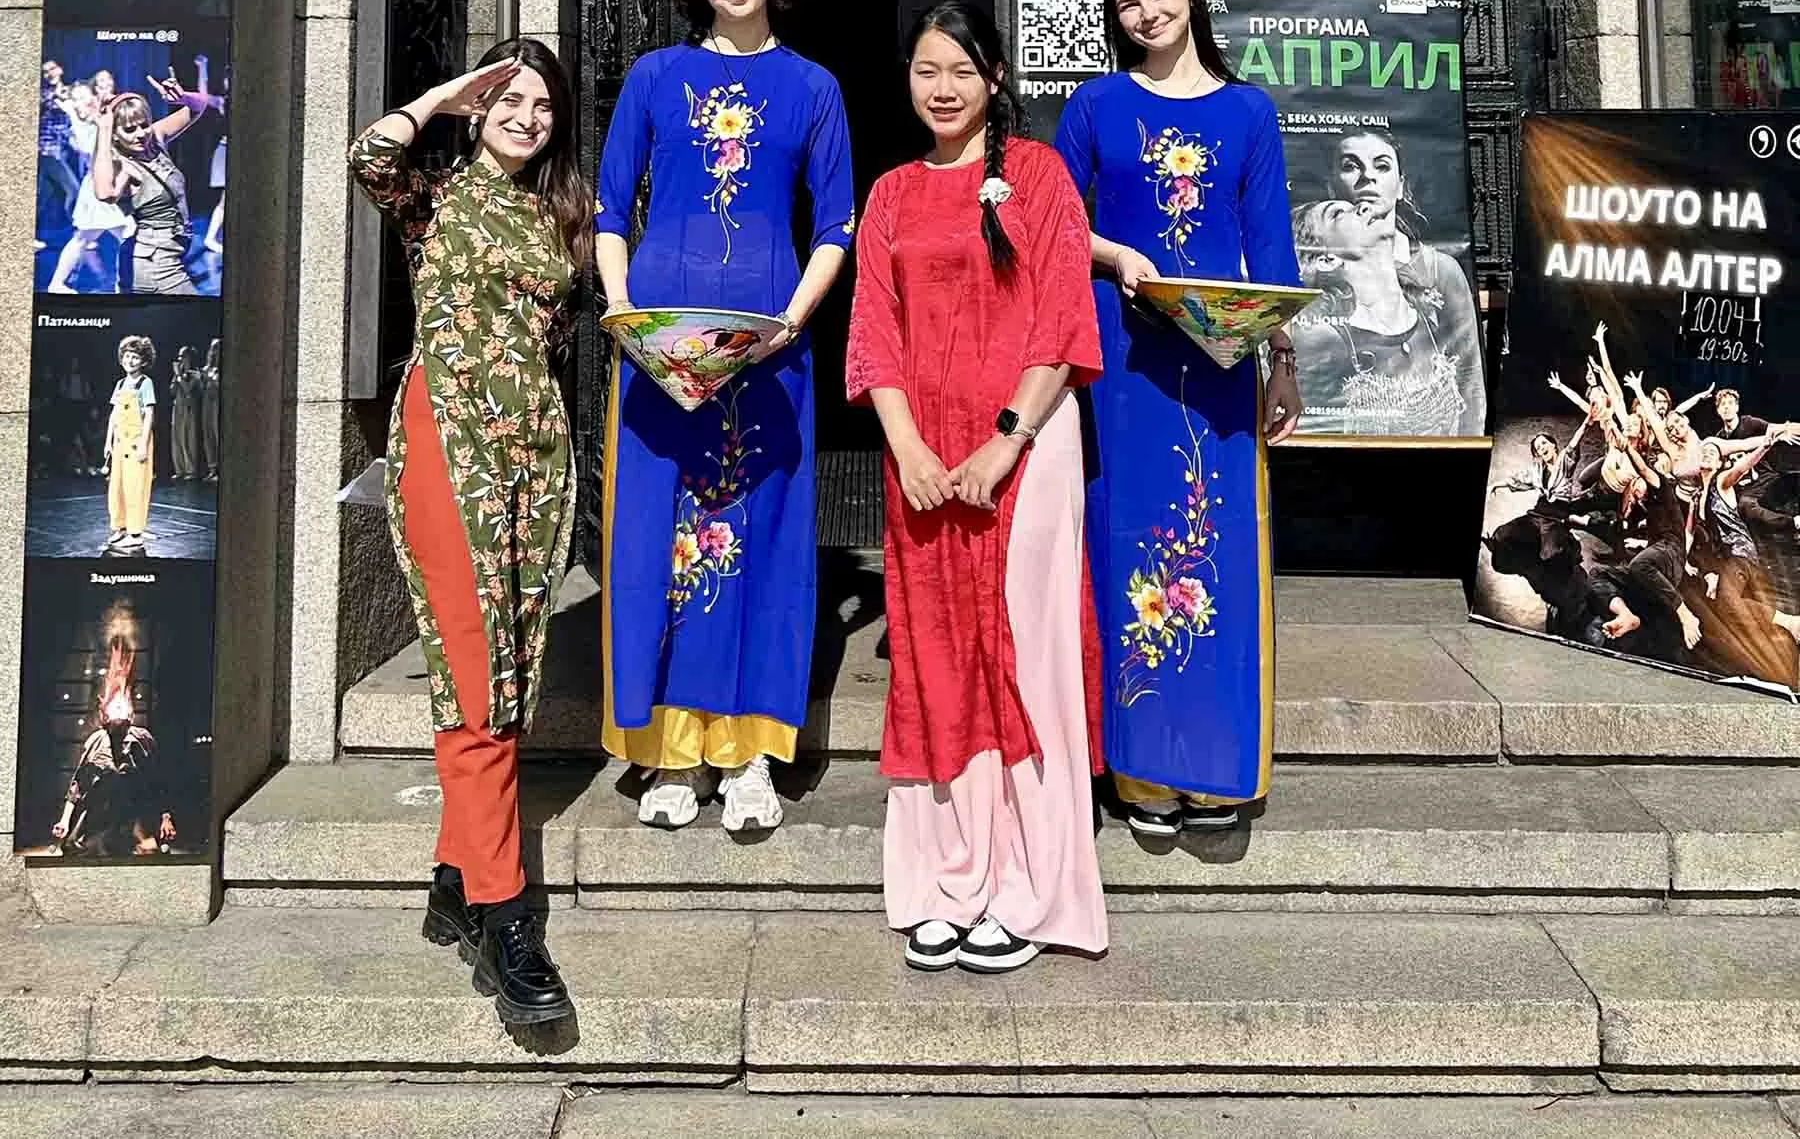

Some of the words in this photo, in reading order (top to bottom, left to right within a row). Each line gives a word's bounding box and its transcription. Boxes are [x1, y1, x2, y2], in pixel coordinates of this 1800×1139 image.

[95, 29, 137, 43] Шоуто
[138, 31, 154, 41] на
[155, 29, 180, 43] @@
[1249, 17, 1370, 38] ПРОГРАМА
[1236, 38, 1462, 92] АПРИЛ
[1287, 112, 1317, 125] БЕКА
[1318, 114, 1361, 127] ХОБАК,
[1362, 115, 1390, 129] САЩ
[1565, 184, 1702, 226] ШОУТО
[1712, 189, 1768, 230] НА
[1544, 242, 1652, 286] АЛМА
[1658, 249, 1783, 295] АЛТЕР
[38, 314, 111, 329] Патиланци
[1690, 296, 1745, 338] 10.04
[90, 573, 156, 585] Задушница
